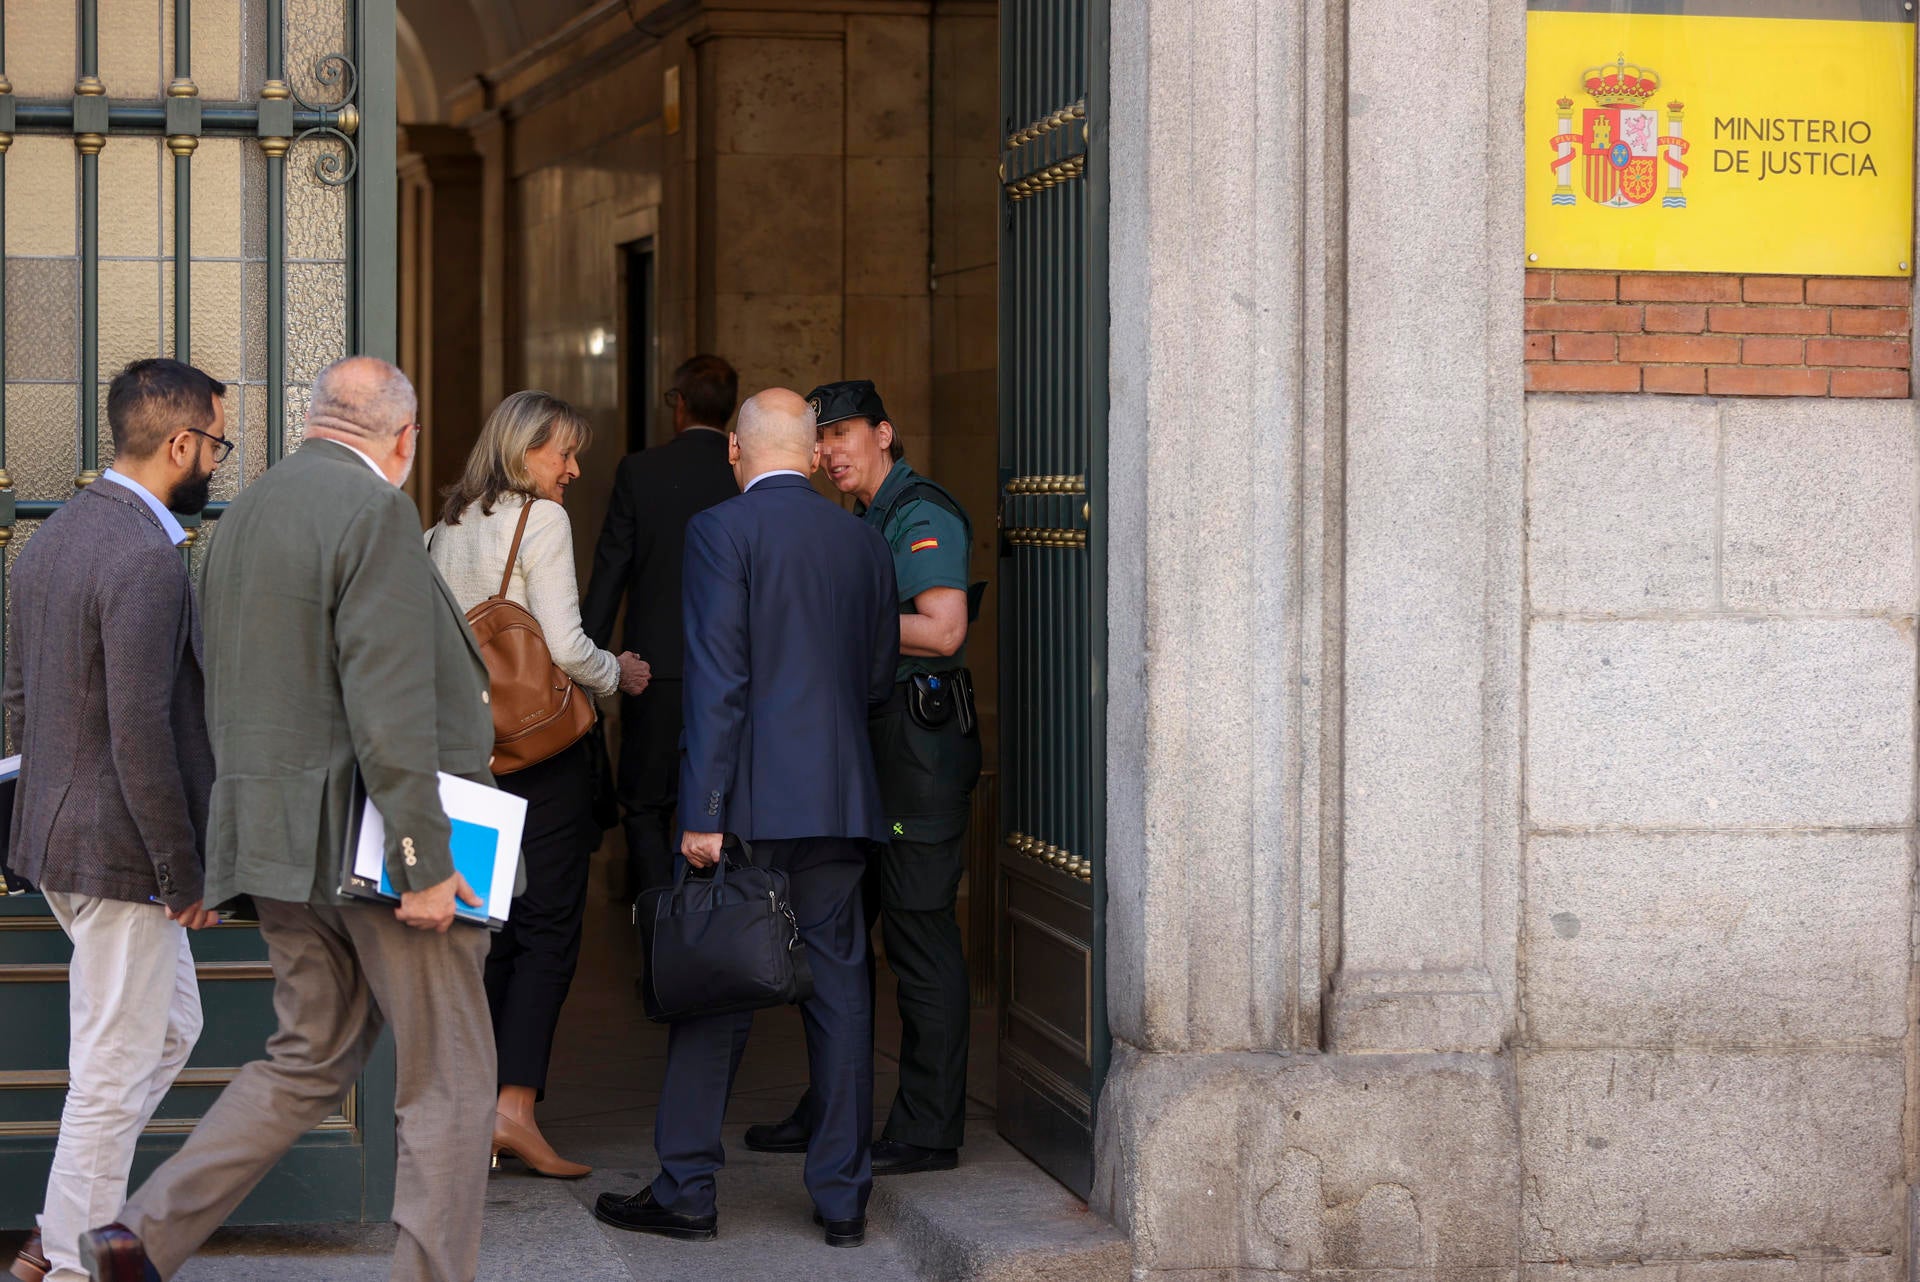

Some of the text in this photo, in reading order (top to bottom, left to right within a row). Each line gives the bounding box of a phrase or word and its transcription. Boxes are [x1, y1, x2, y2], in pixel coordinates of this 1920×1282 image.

[1714, 117, 1871, 144] MINISTERIO
[1714, 150, 1878, 181] DE JUSTICIA
